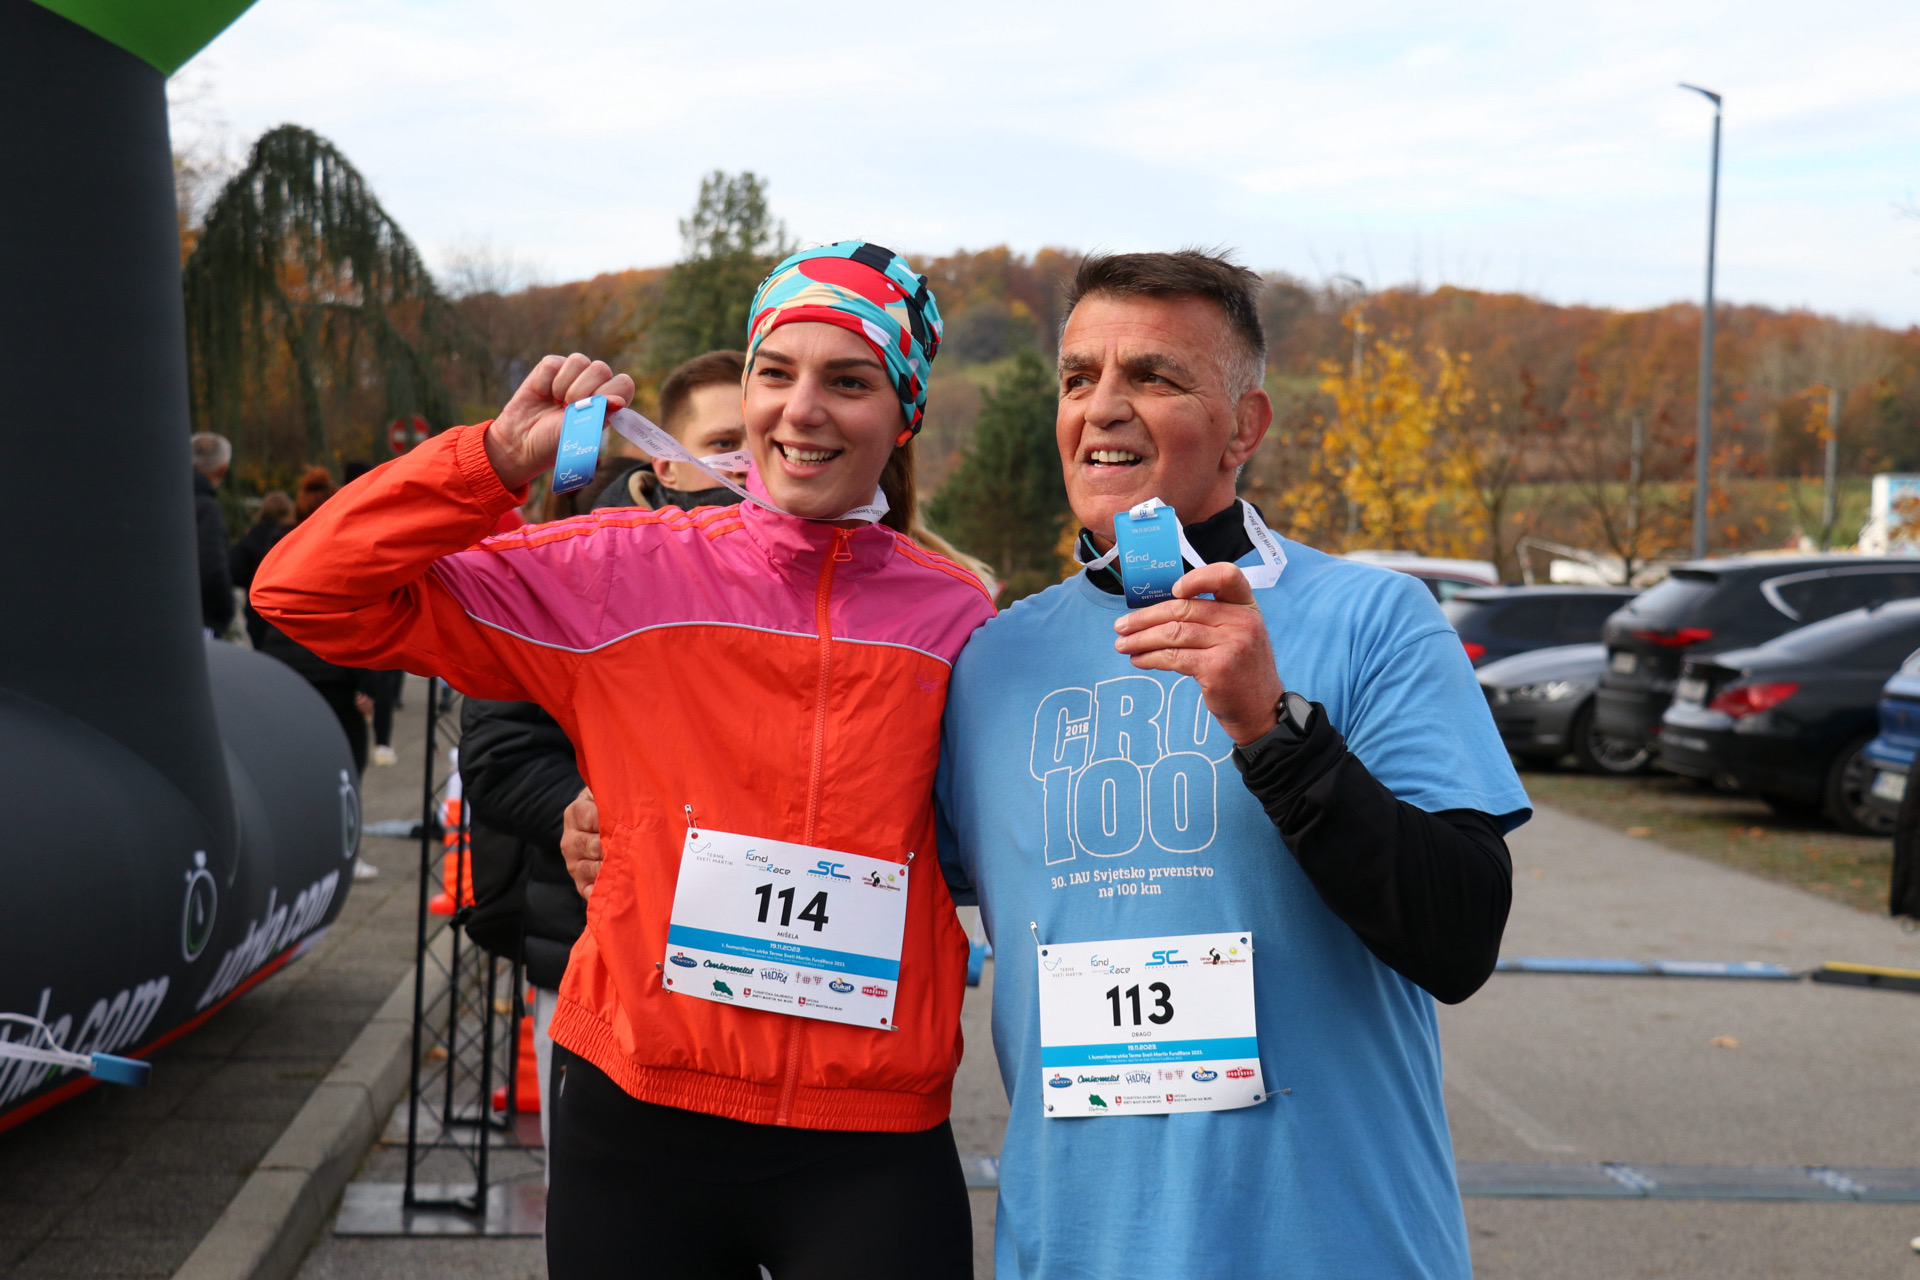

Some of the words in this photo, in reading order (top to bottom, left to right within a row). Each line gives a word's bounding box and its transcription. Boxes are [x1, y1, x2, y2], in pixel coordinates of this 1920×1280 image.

[1255, 527, 1266, 540] SVETI
[1263, 539, 1277, 557] MARTIN
[1125, 550, 1149, 563] Fund
[1150, 560, 1177, 569] Race
[1065, 722, 1089, 737] 2018
[1044, 751, 1217, 865] 100
[746, 849, 768, 862] Fund
[766, 864, 791, 875] Race
[808, 861, 851, 879] SC
[1052, 876, 1067, 889] 30.
[1069, 872, 1090, 885] IAU
[1093, 867, 1145, 883] Svjetsko
[1149, 865, 1214, 881] prvenstvo
[1099, 886, 1113, 897] na
[1116, 884, 1137, 895] 100
[1140, 883, 1162, 894] km
[755, 883, 829, 932] 114
[1091, 954, 1109, 967] Fund
[1145, 950, 1188, 966] SC
[1110, 965, 1130, 974] Race
[832, 982, 851, 991] Dukat
[1106, 981, 1174, 1027] 113
